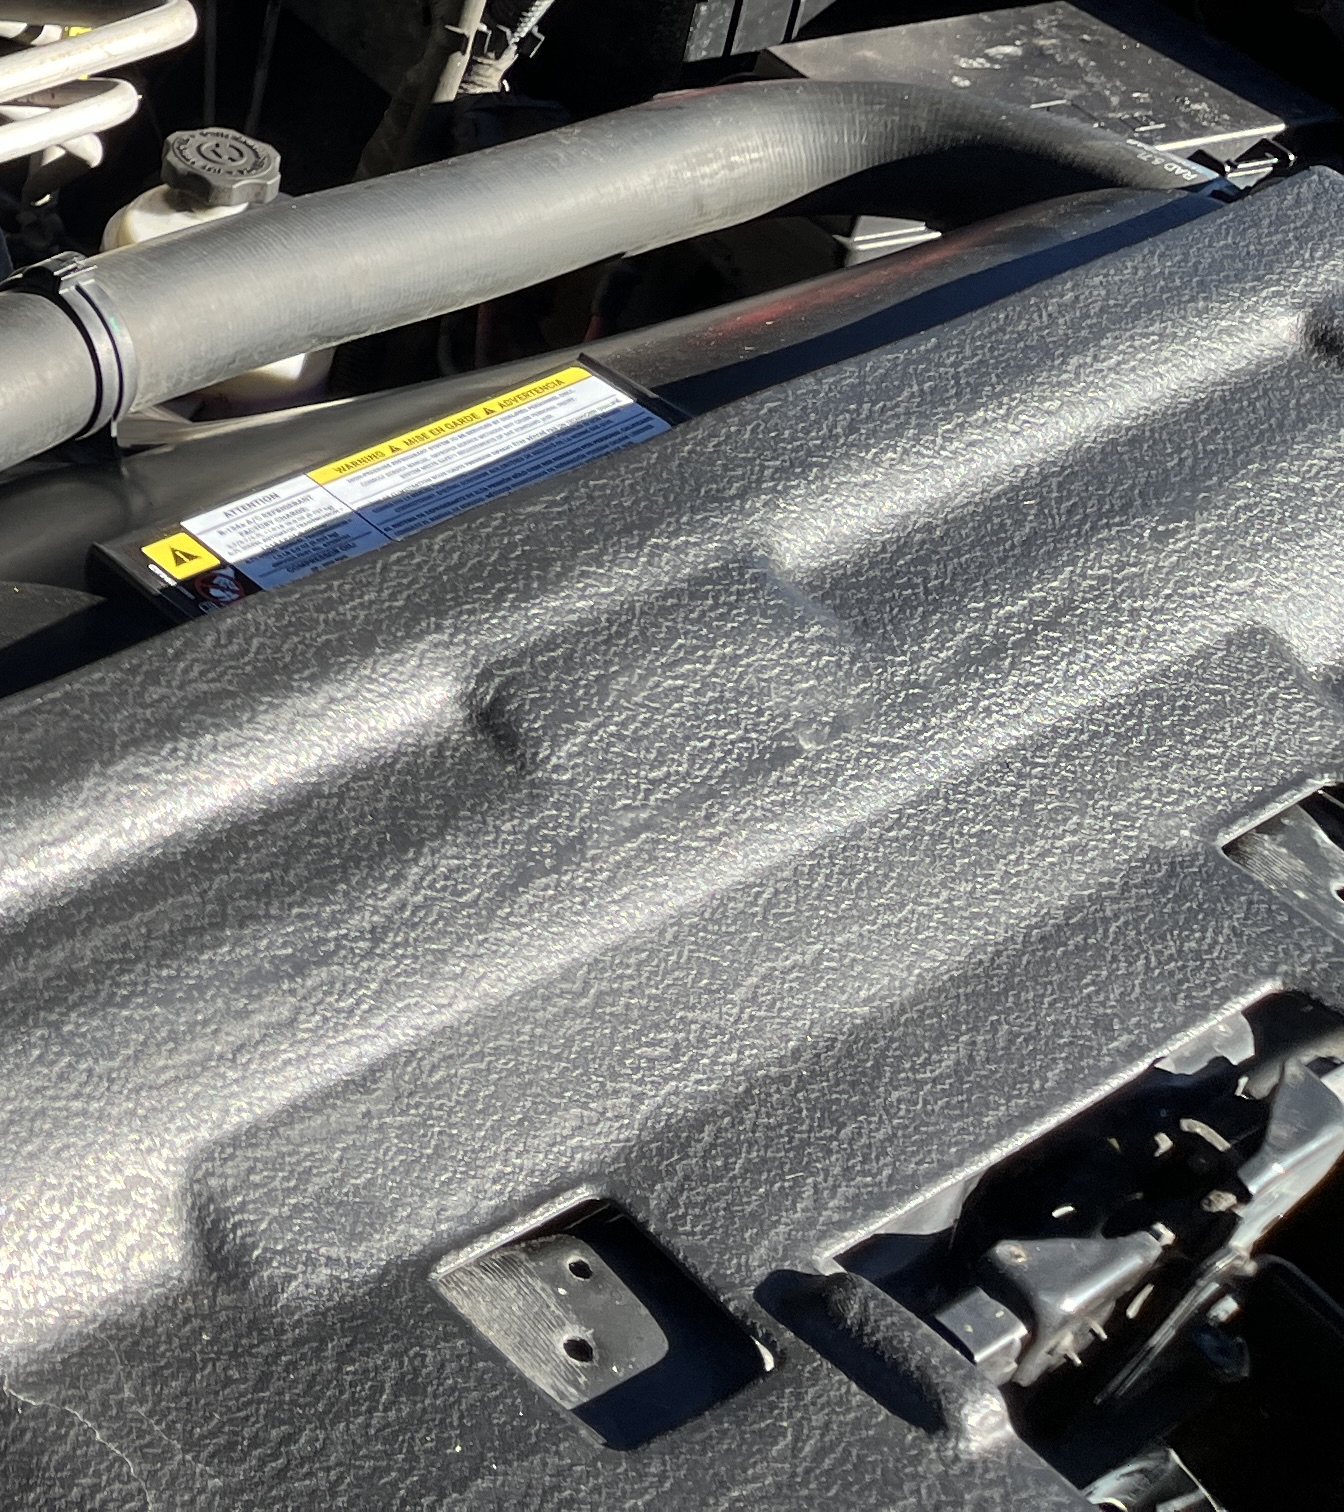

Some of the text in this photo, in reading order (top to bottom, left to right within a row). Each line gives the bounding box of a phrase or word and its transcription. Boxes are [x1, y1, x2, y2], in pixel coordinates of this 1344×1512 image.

[333, 378, 567, 473] WARNING MISE EN GARDE ADVERTENCIA
[220, 491, 282, 518] ATTENTION
